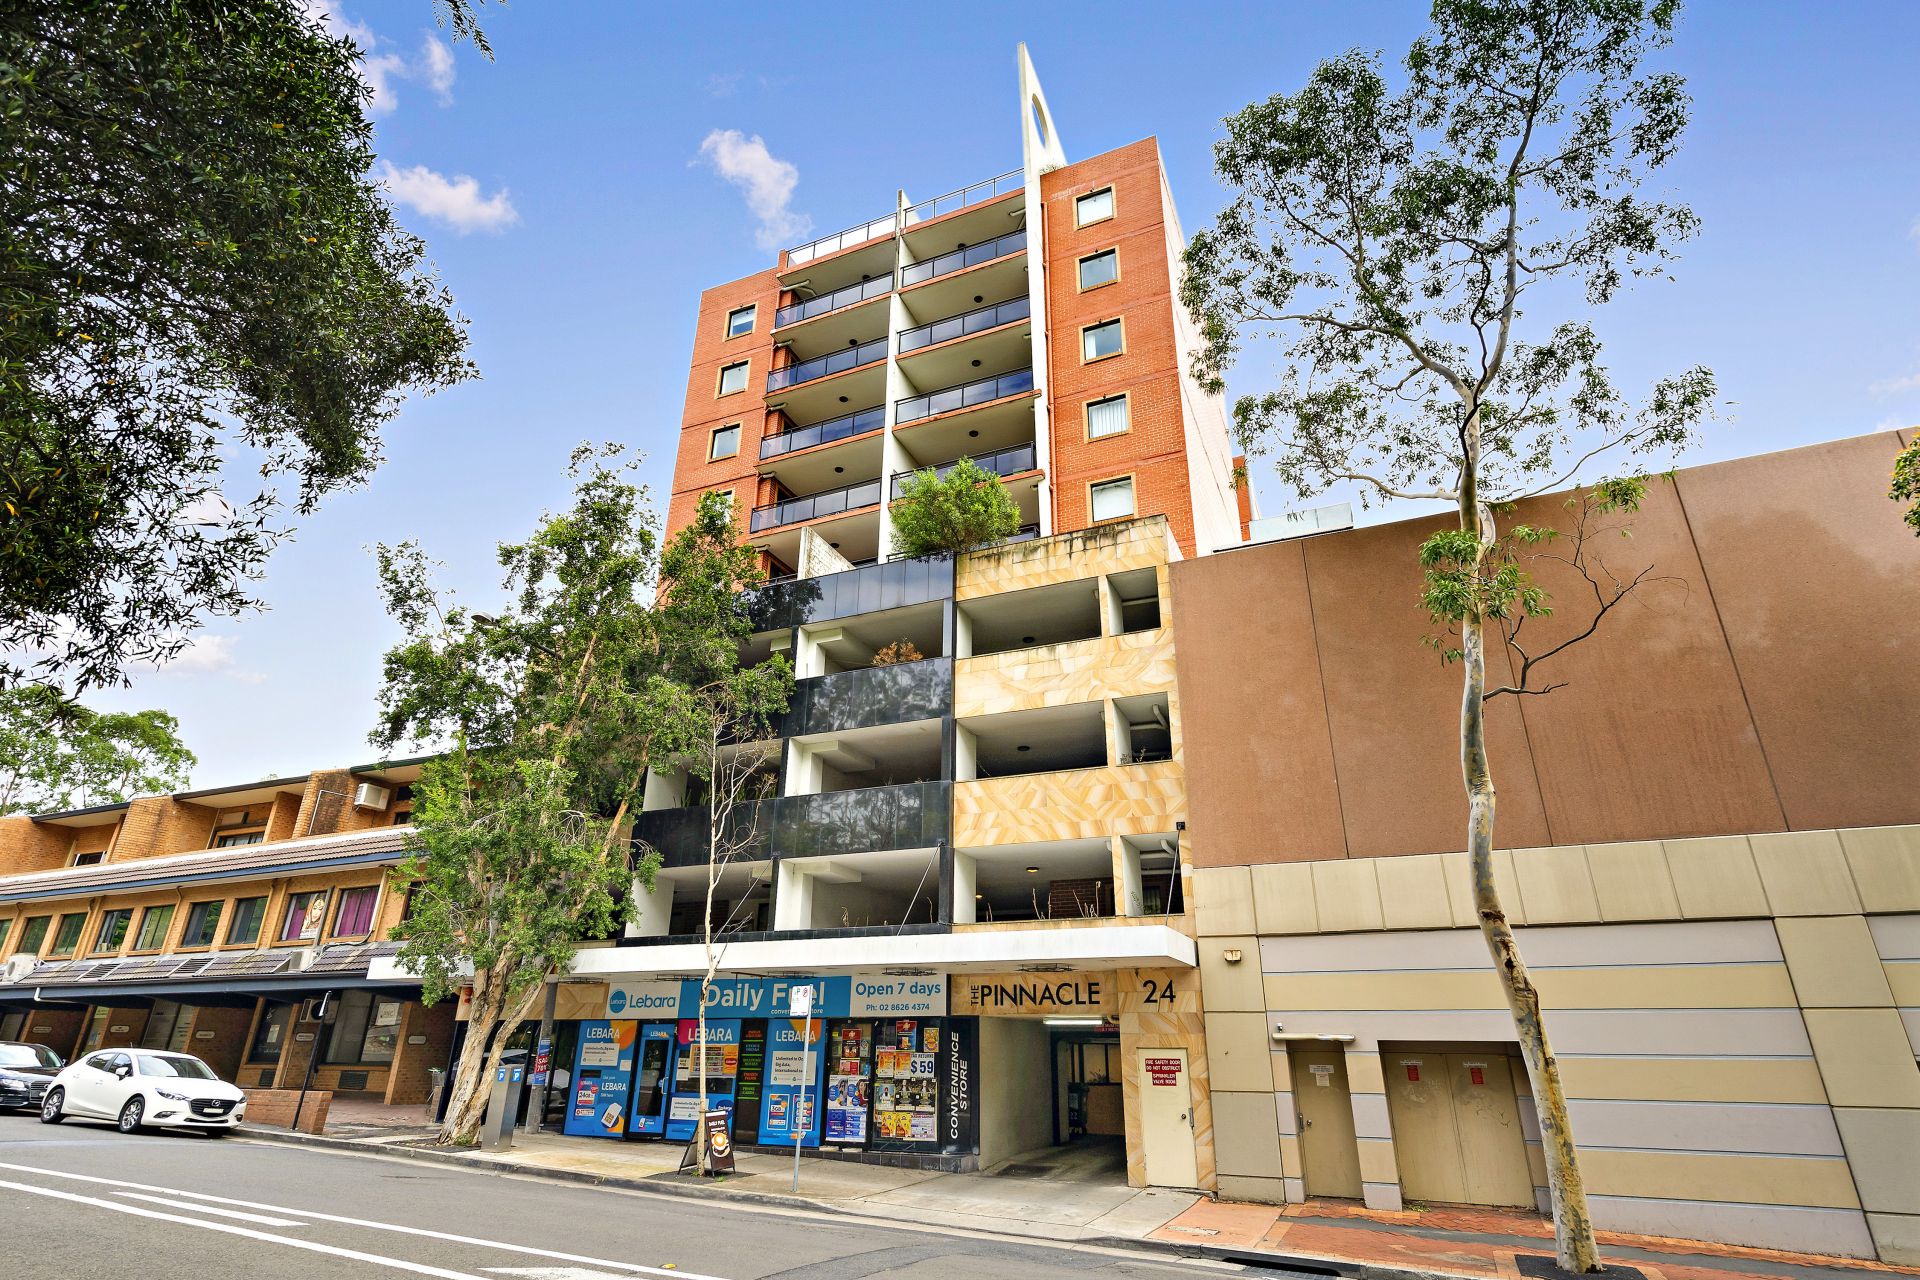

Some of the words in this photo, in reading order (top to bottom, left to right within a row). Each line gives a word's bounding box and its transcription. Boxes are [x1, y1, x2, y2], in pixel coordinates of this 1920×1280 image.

[704, 983, 764, 1011] Daily
[855, 982, 894, 998] Open
[897, 983, 905, 995] 7
[909, 981, 942, 997] days
[971, 984, 979, 1006] THE
[980, 982, 1101, 1007] PINNACLE
[1143, 979, 1176, 1004] 24
[629, 993, 676, 1009] Lebara
[911, 1003, 930, 1011] 4374
[586, 1027, 620, 1039] LEBARA
[601, 1082, 627, 1091] LEBARA
[950, 1031, 959, 1139] CONVENIENCE
[960, 1059, 968, 1110] STORE
